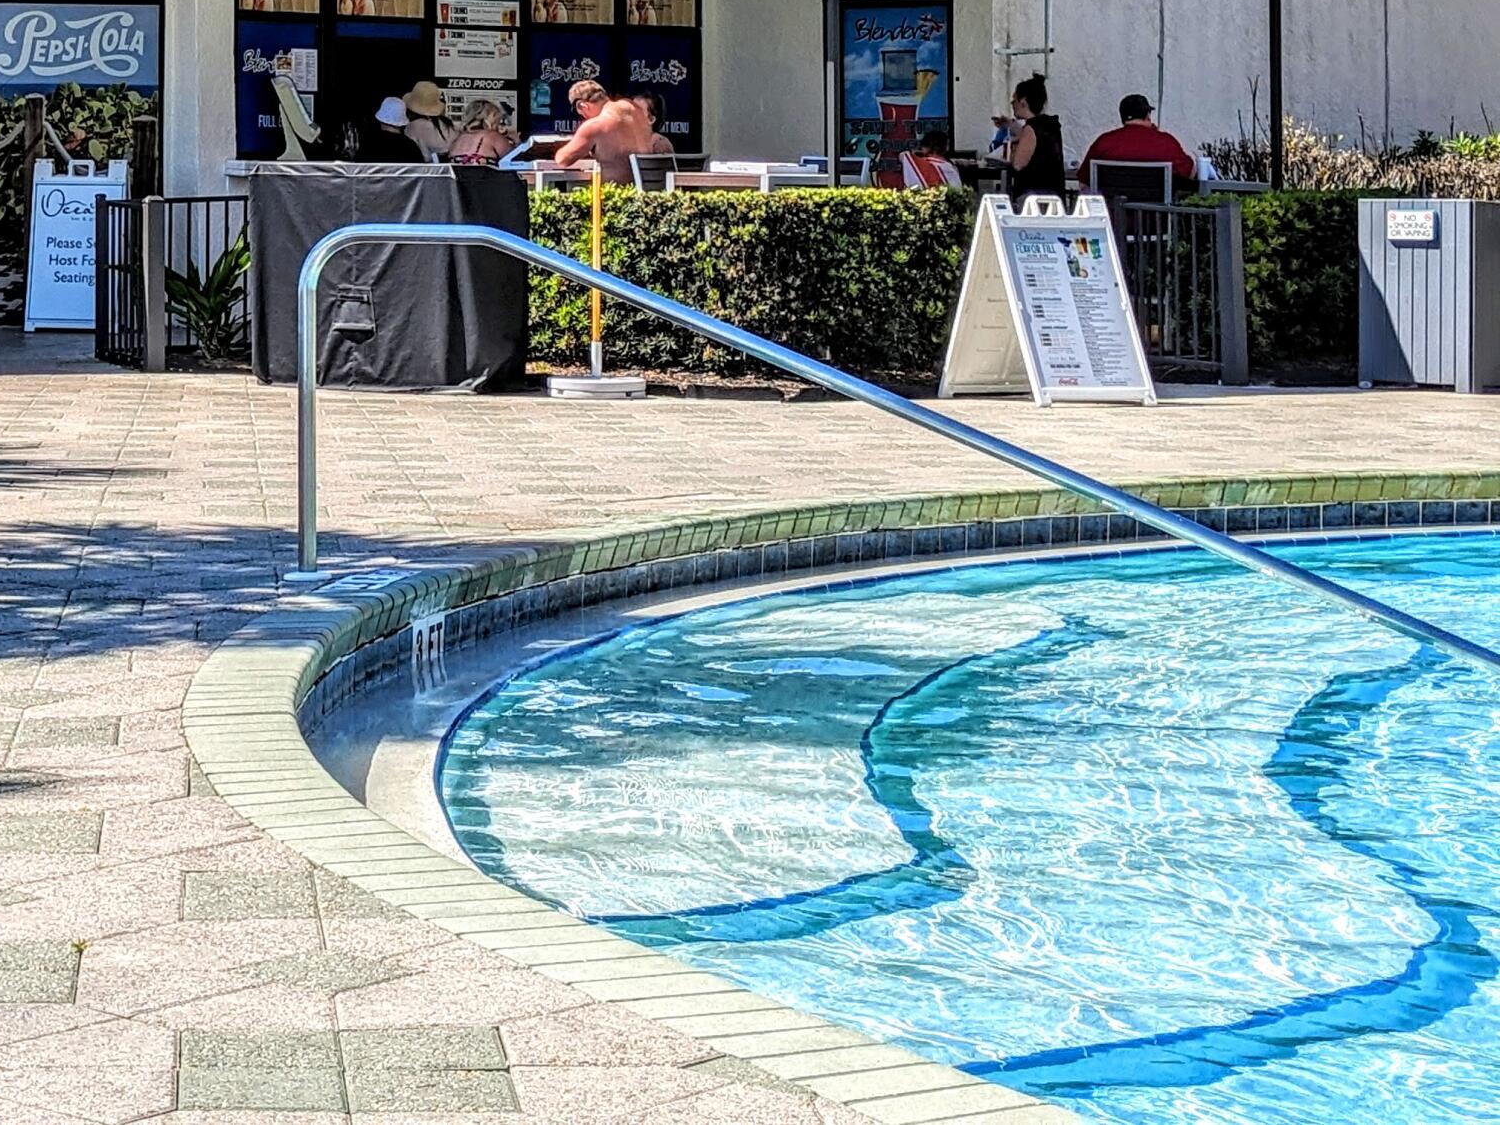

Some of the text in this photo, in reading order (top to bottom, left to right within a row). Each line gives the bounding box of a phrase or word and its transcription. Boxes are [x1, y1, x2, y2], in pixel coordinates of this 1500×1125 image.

[854, 17, 931, 43] Blenders
[447, 78, 505, 89] ZERO PROOF
[258, 114, 277, 128] FULL
[670, 121, 690, 134] MENU
[40, 188, 95, 217] Ocea
[1403, 214, 1417, 222] NO
[1392, 221, 1428, 229] SMOKING
[1390, 229, 1431, 237] OR VAPING
[46, 237, 83, 249] Please
[48, 254, 96, 266] Host Fo
[53, 271, 96, 287] Seating
[414, 621, 444, 661] 3 FT
